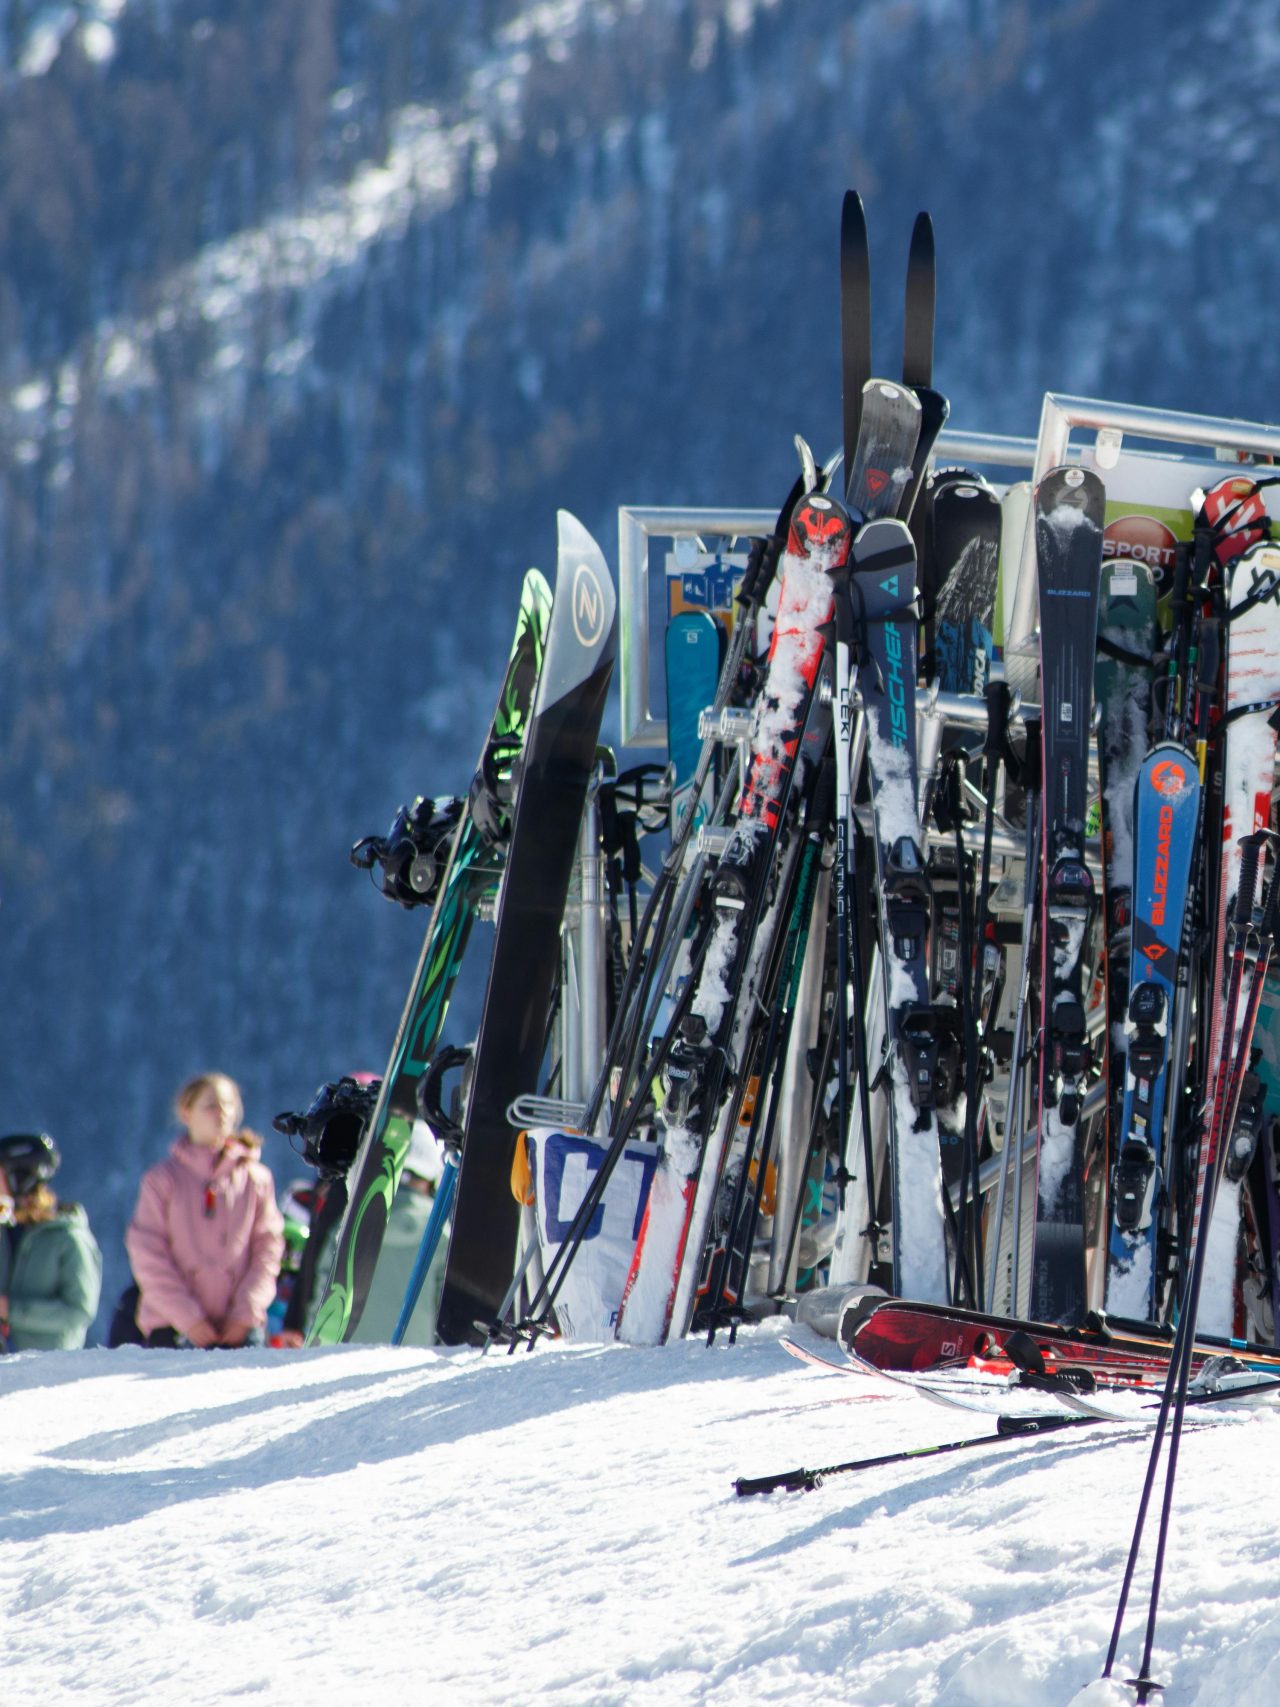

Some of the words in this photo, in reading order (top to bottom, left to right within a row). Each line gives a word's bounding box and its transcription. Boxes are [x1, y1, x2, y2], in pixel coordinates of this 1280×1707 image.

[1103, 540, 1176, 564] SPORT
[840, 688, 850, 742] LEKI
[1152, 805, 1173, 926] BLIZZARD
